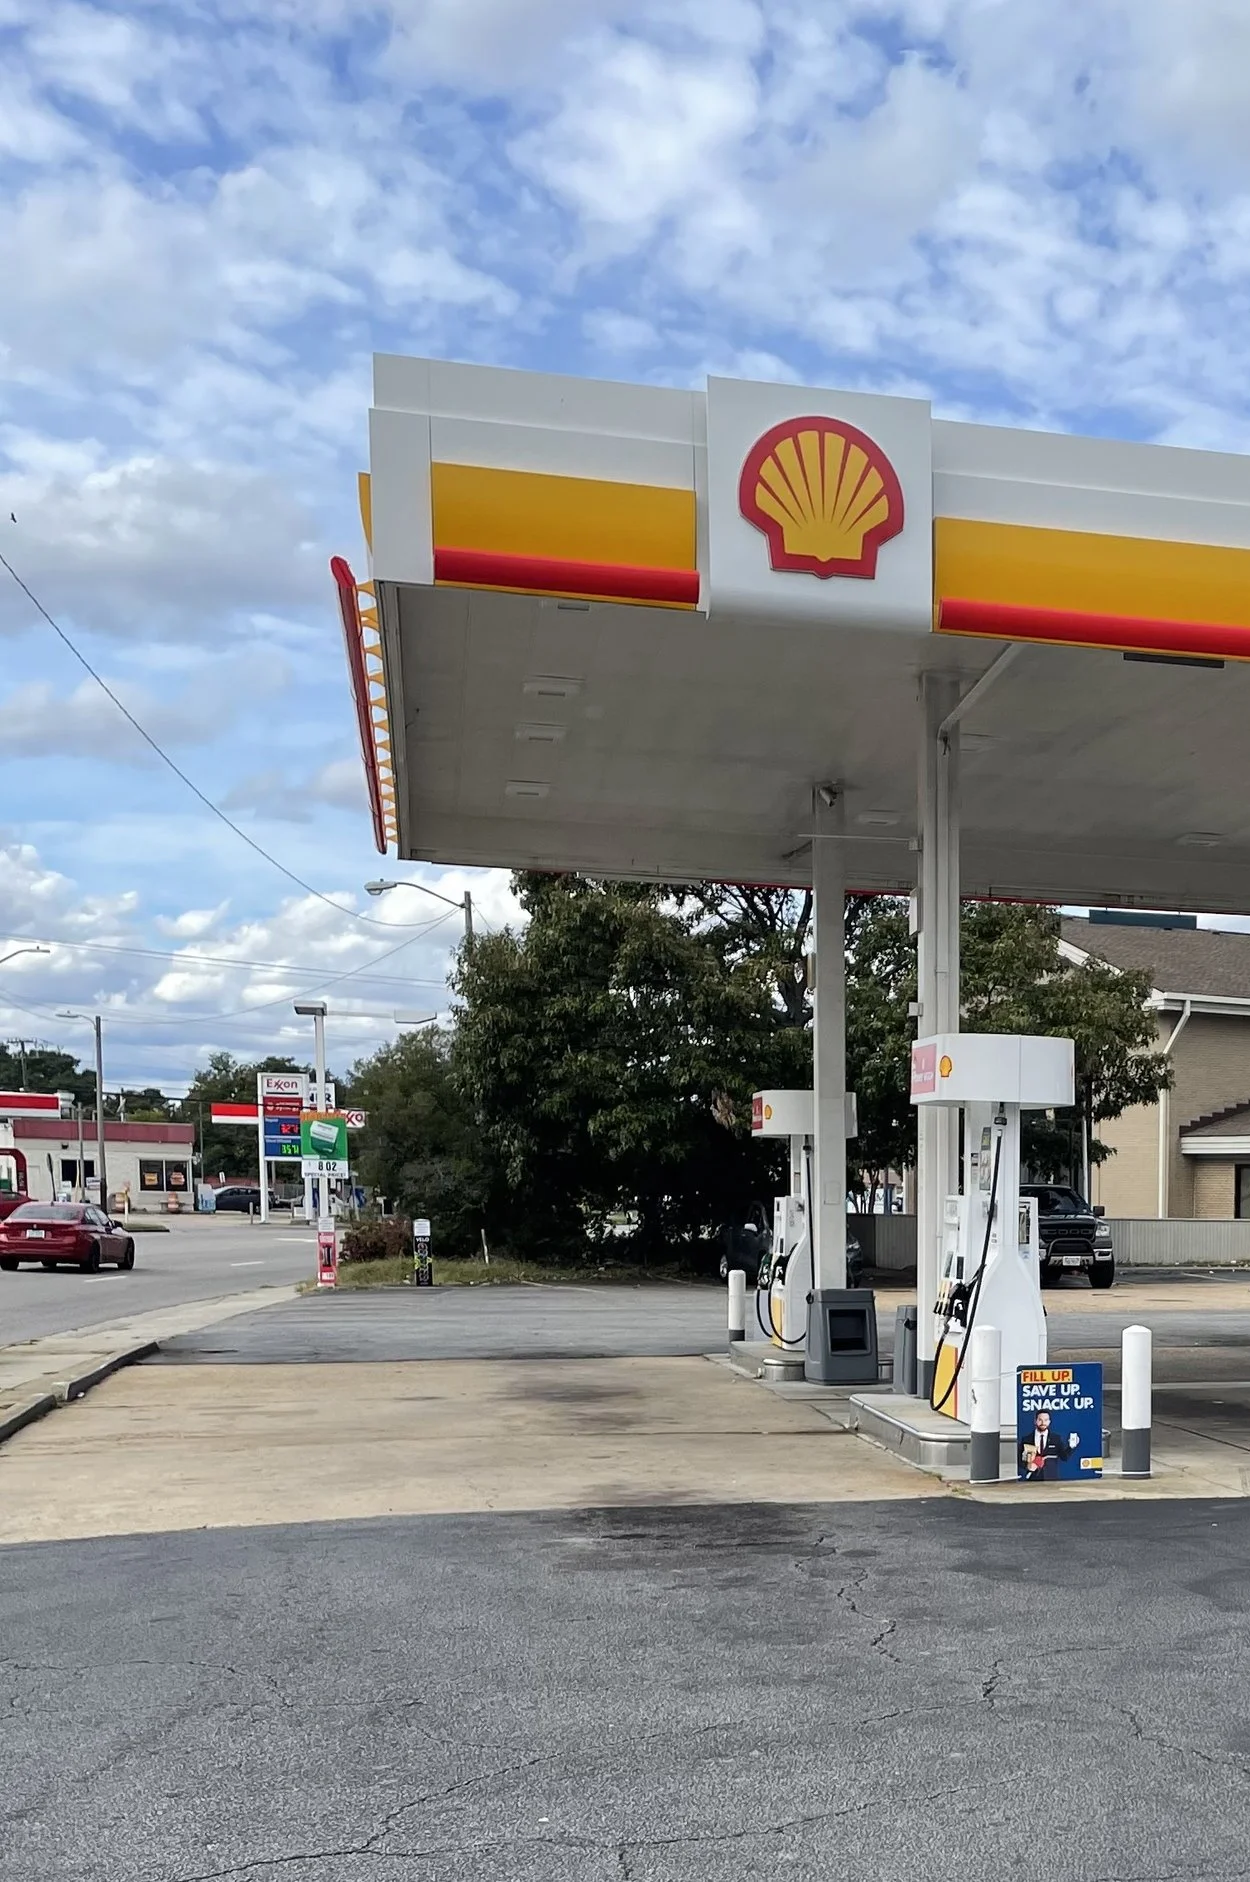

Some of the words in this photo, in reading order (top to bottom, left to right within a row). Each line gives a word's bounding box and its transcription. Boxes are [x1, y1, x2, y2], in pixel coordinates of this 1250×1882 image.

[266, 1078, 298, 1091] Exxon
[1023, 1371, 1046, 1382] FILL
[1051, 1371, 1070, 1381] UP.
[1022, 1384, 1057, 1397] SAVE
[1061, 1384, 1080, 1396] UP.
[1022, 1398, 1070, 1411] SNACK
[1074, 1397, 1094, 1409] UP.
